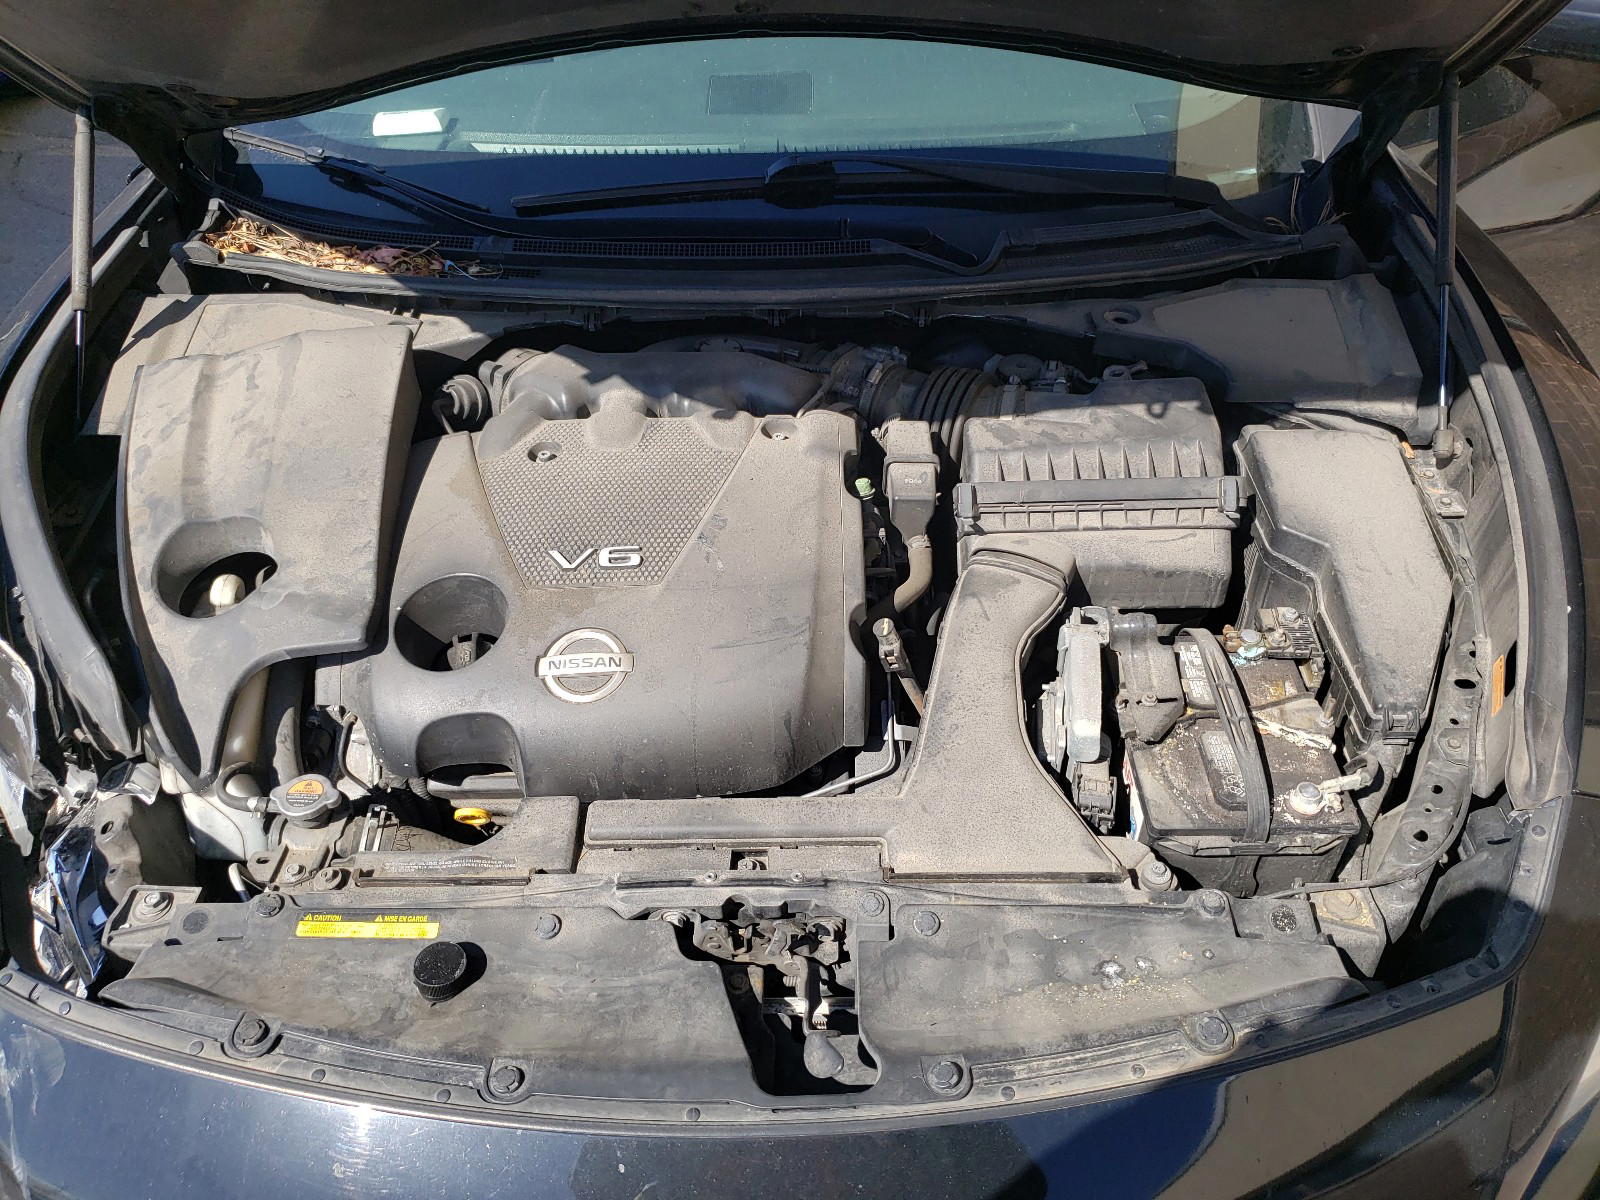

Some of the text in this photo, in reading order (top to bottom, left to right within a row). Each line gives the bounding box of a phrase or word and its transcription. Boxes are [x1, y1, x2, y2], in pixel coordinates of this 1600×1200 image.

[548, 546, 643, 569] V6
[548, 656, 622, 671] NISSAN
[313, 914, 342, 922] CAUTION
[384, 914, 398, 922] MISE
